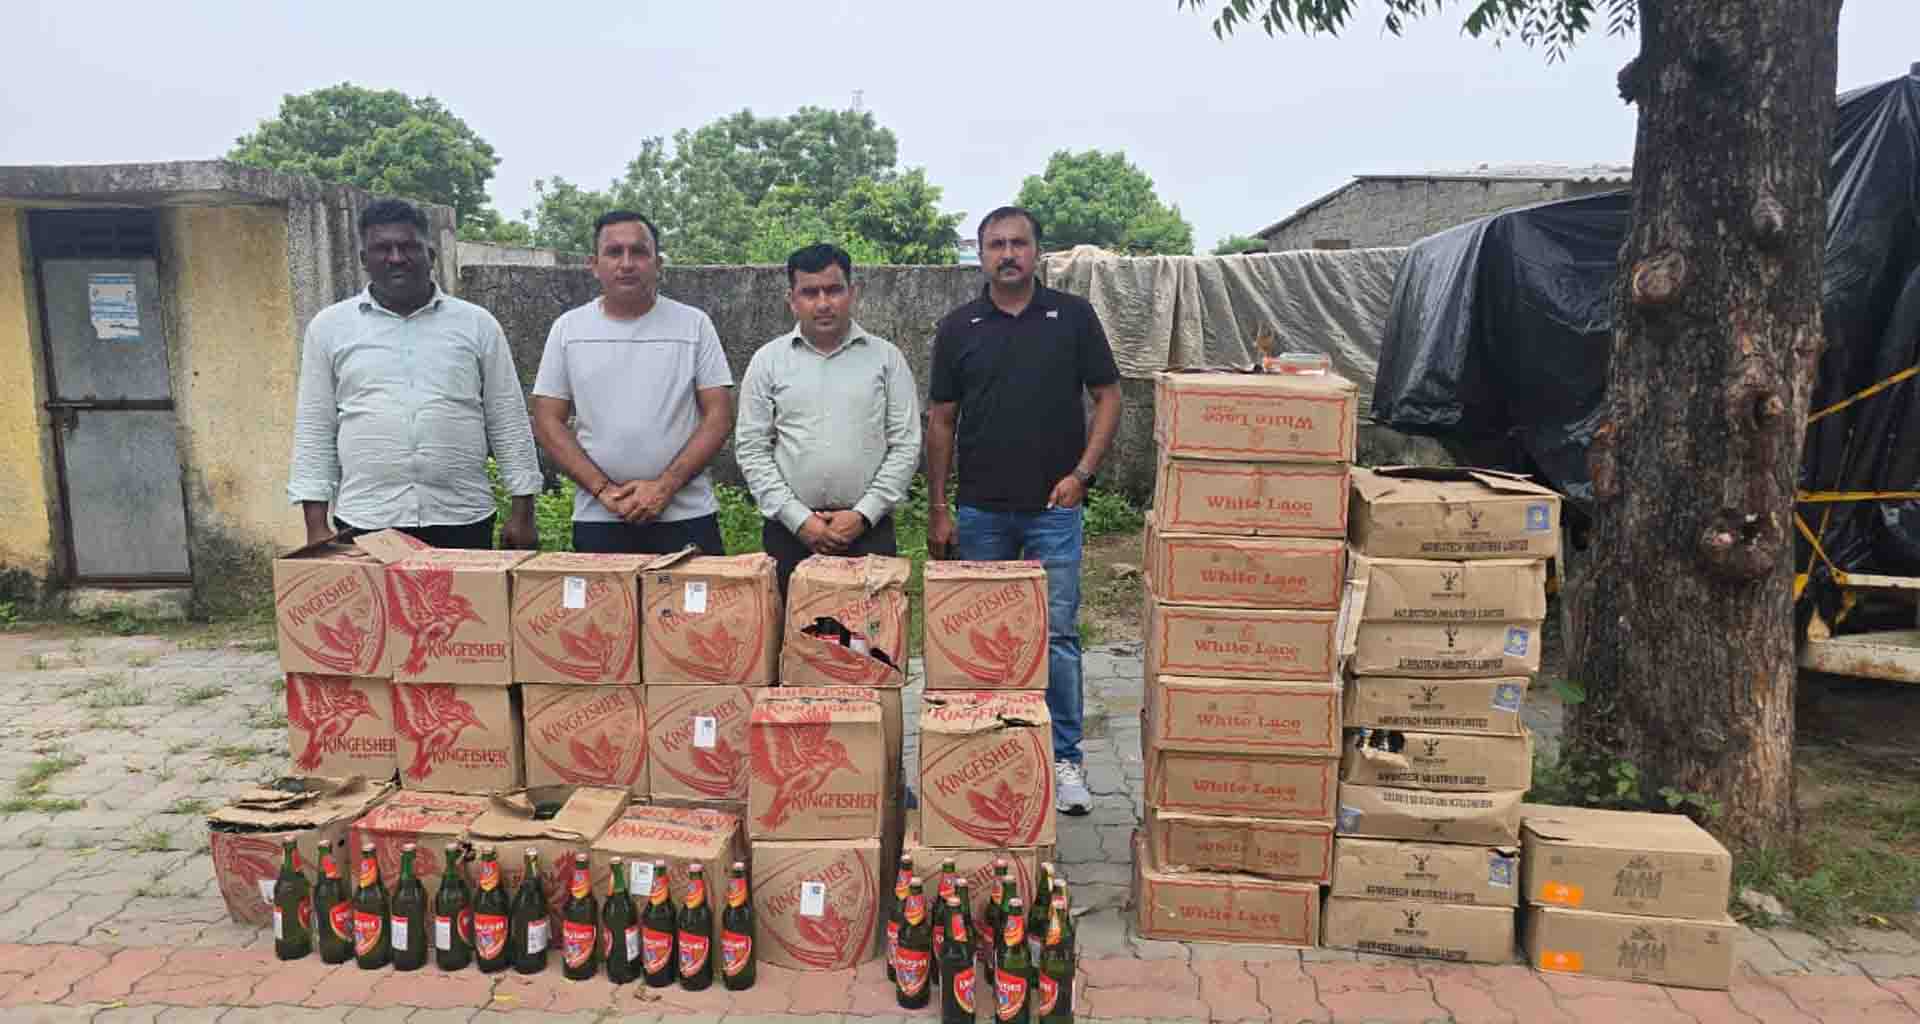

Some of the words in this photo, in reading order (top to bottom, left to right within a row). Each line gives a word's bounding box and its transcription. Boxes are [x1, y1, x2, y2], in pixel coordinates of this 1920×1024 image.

[288, 574, 361, 626] KINGFISHER
[942, 582, 1026, 636] KINGFISHER
[425, 640, 507, 659] KINGFISHER
[540, 691, 626, 744] KINGFISHER
[322, 735, 397, 753] KINGFISHER
[432, 748, 507, 764] KINGFISHER
[933, 736, 1024, 798] KINGFISHER
[789, 791, 880, 809] KINGFISHER
